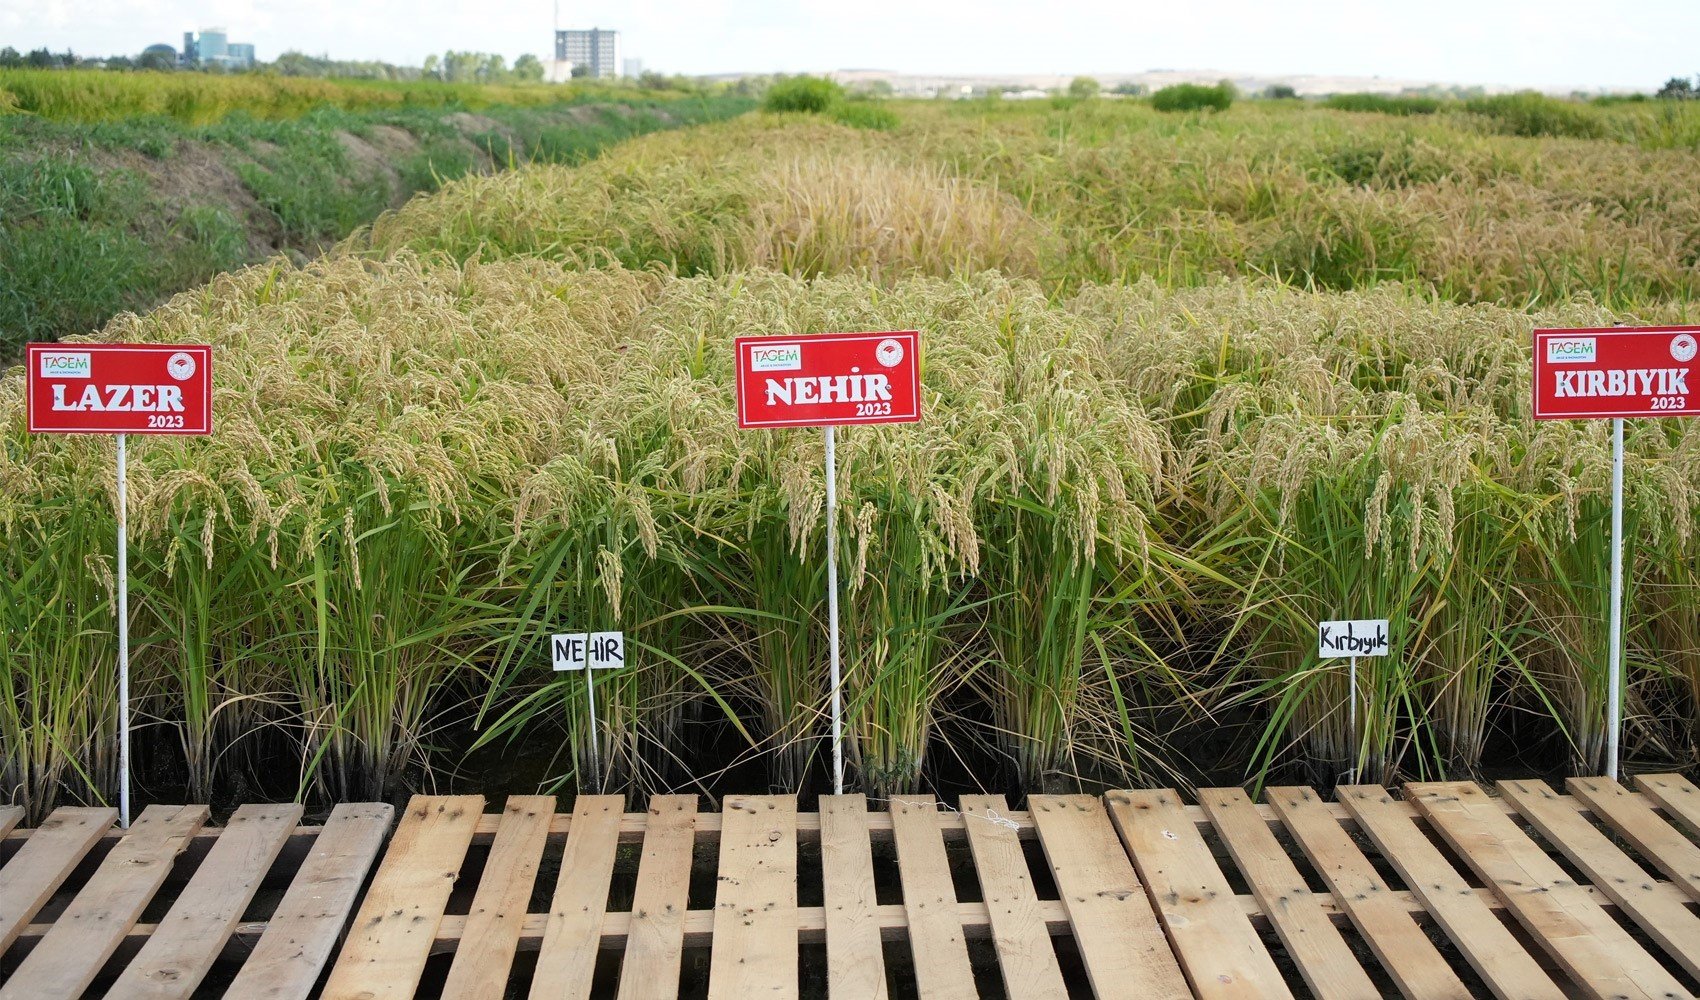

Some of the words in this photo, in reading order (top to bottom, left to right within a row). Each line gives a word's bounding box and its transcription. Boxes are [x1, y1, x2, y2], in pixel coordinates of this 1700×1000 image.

[1550, 342, 1593, 354] TAGEM
[753, 349, 798, 362] TAGEM
[43, 357, 87, 369] TAGEM
[765, 366, 892, 406] NEHİR
[1554, 368, 1689, 397] KIRBIYIK
[52, 384, 185, 412] LAZER
[1650, 397, 1686, 410] 2023
[856, 402, 892, 416] 2023
[148, 415, 184, 428] 2023
